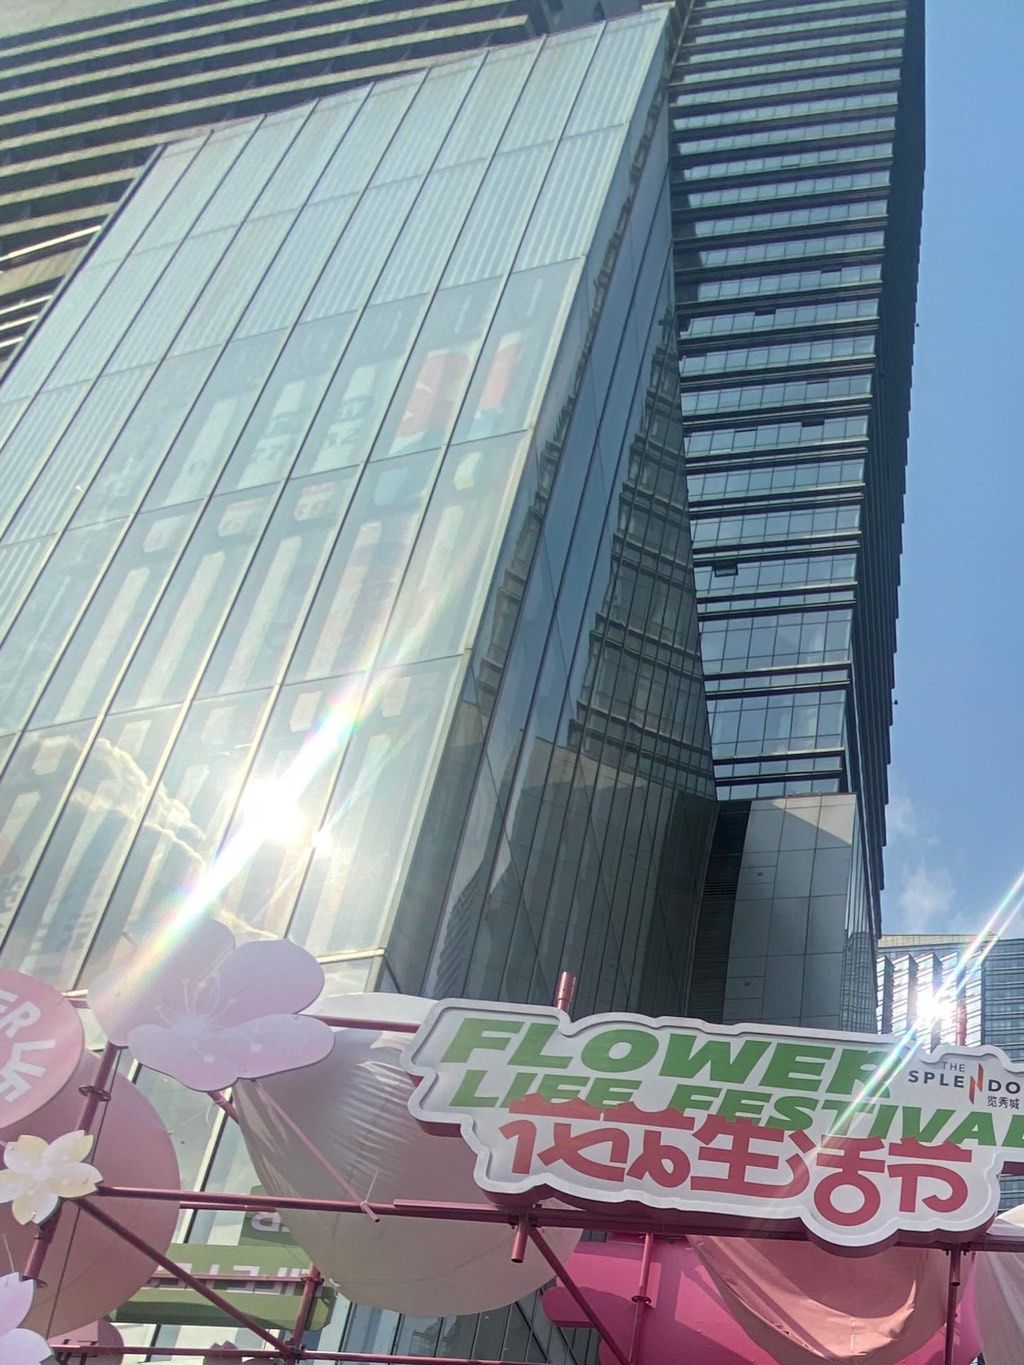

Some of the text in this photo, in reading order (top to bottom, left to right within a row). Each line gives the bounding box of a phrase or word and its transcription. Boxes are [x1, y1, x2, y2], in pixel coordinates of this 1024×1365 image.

[440, 1017, 903, 1099] FLOWER
[941, 1060, 966, 1073] THE
[450, 1069, 643, 1110] LIFE
[986, 1095, 1021, 1111] 览秀城
